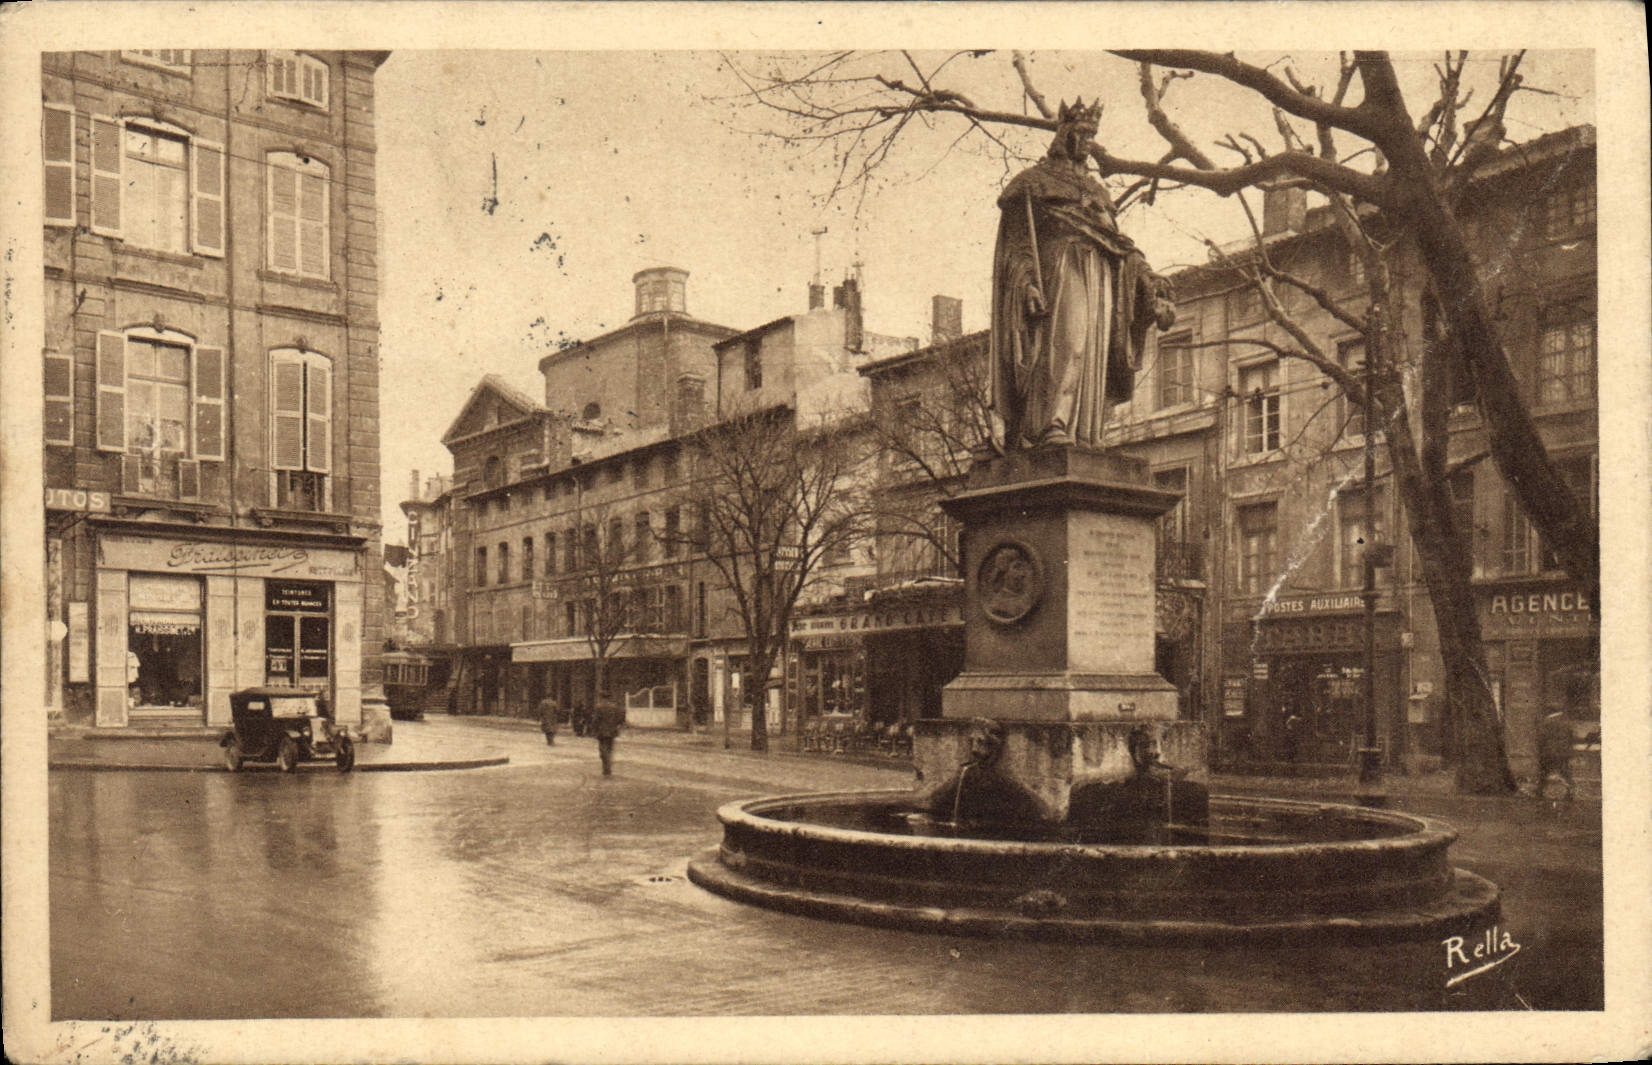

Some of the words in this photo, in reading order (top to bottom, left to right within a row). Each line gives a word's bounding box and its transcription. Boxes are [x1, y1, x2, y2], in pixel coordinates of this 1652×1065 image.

[408, 511, 419, 619] CINZANO
[1266, 601, 1304, 613] POSTES
[1491, 592, 1590, 614] AGENCE
